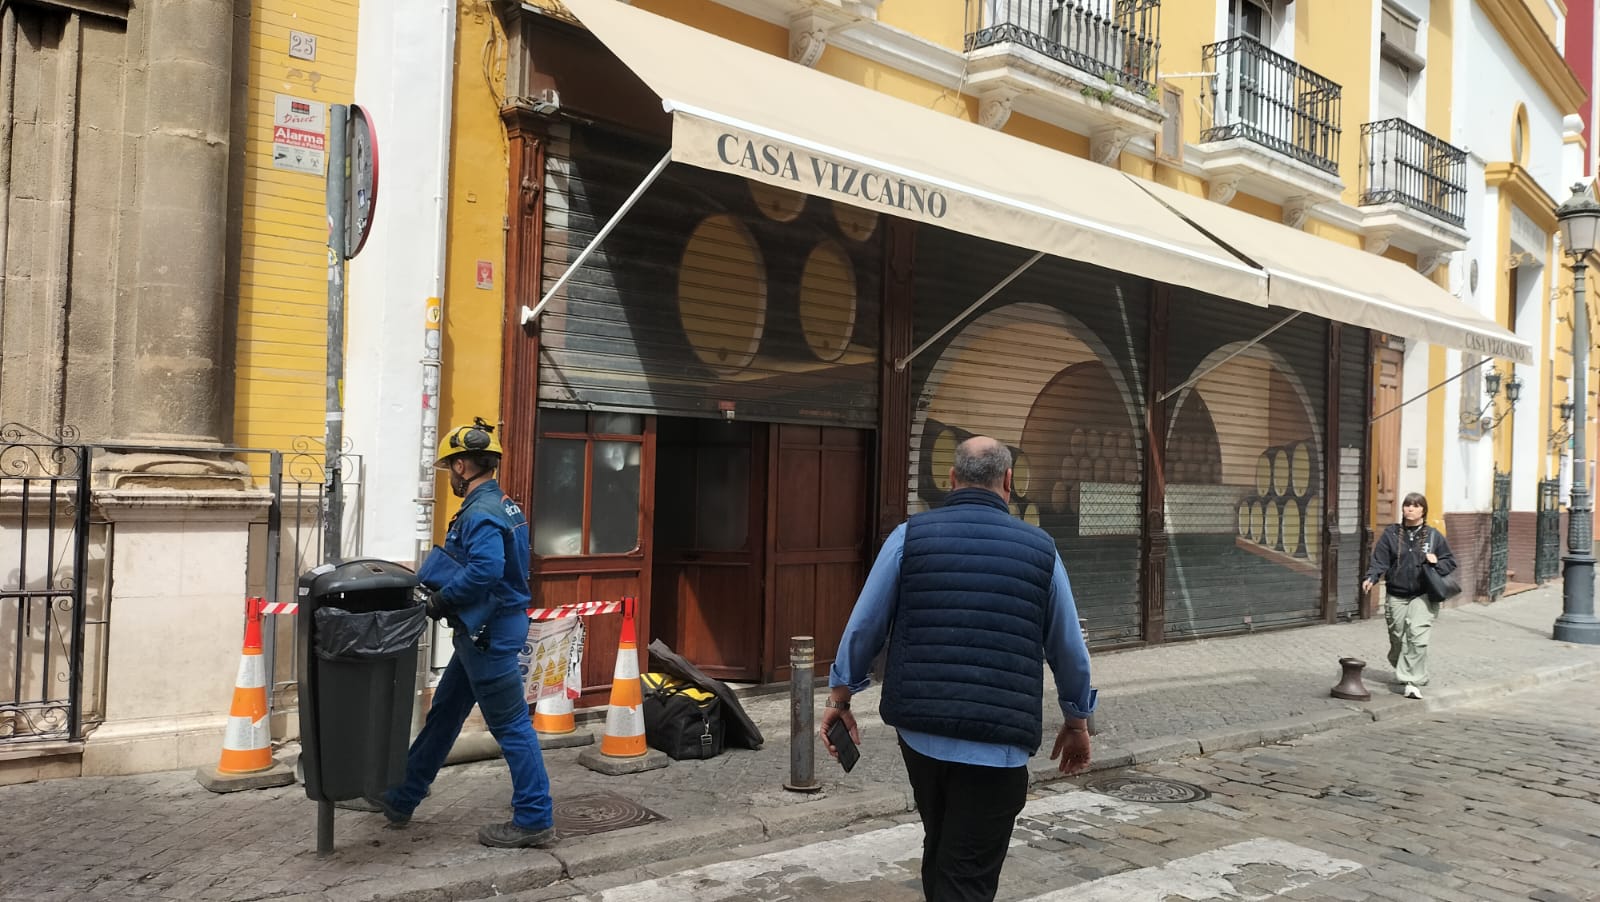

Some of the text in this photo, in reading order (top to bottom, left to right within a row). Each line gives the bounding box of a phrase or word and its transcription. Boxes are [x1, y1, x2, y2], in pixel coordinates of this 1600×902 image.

[292, 35, 313, 55] 25
[275, 127, 323, 145] Alarma
[717, 133, 947, 218] CASA VIZCAÍNO
[1465, 332, 1486, 352] CASA
